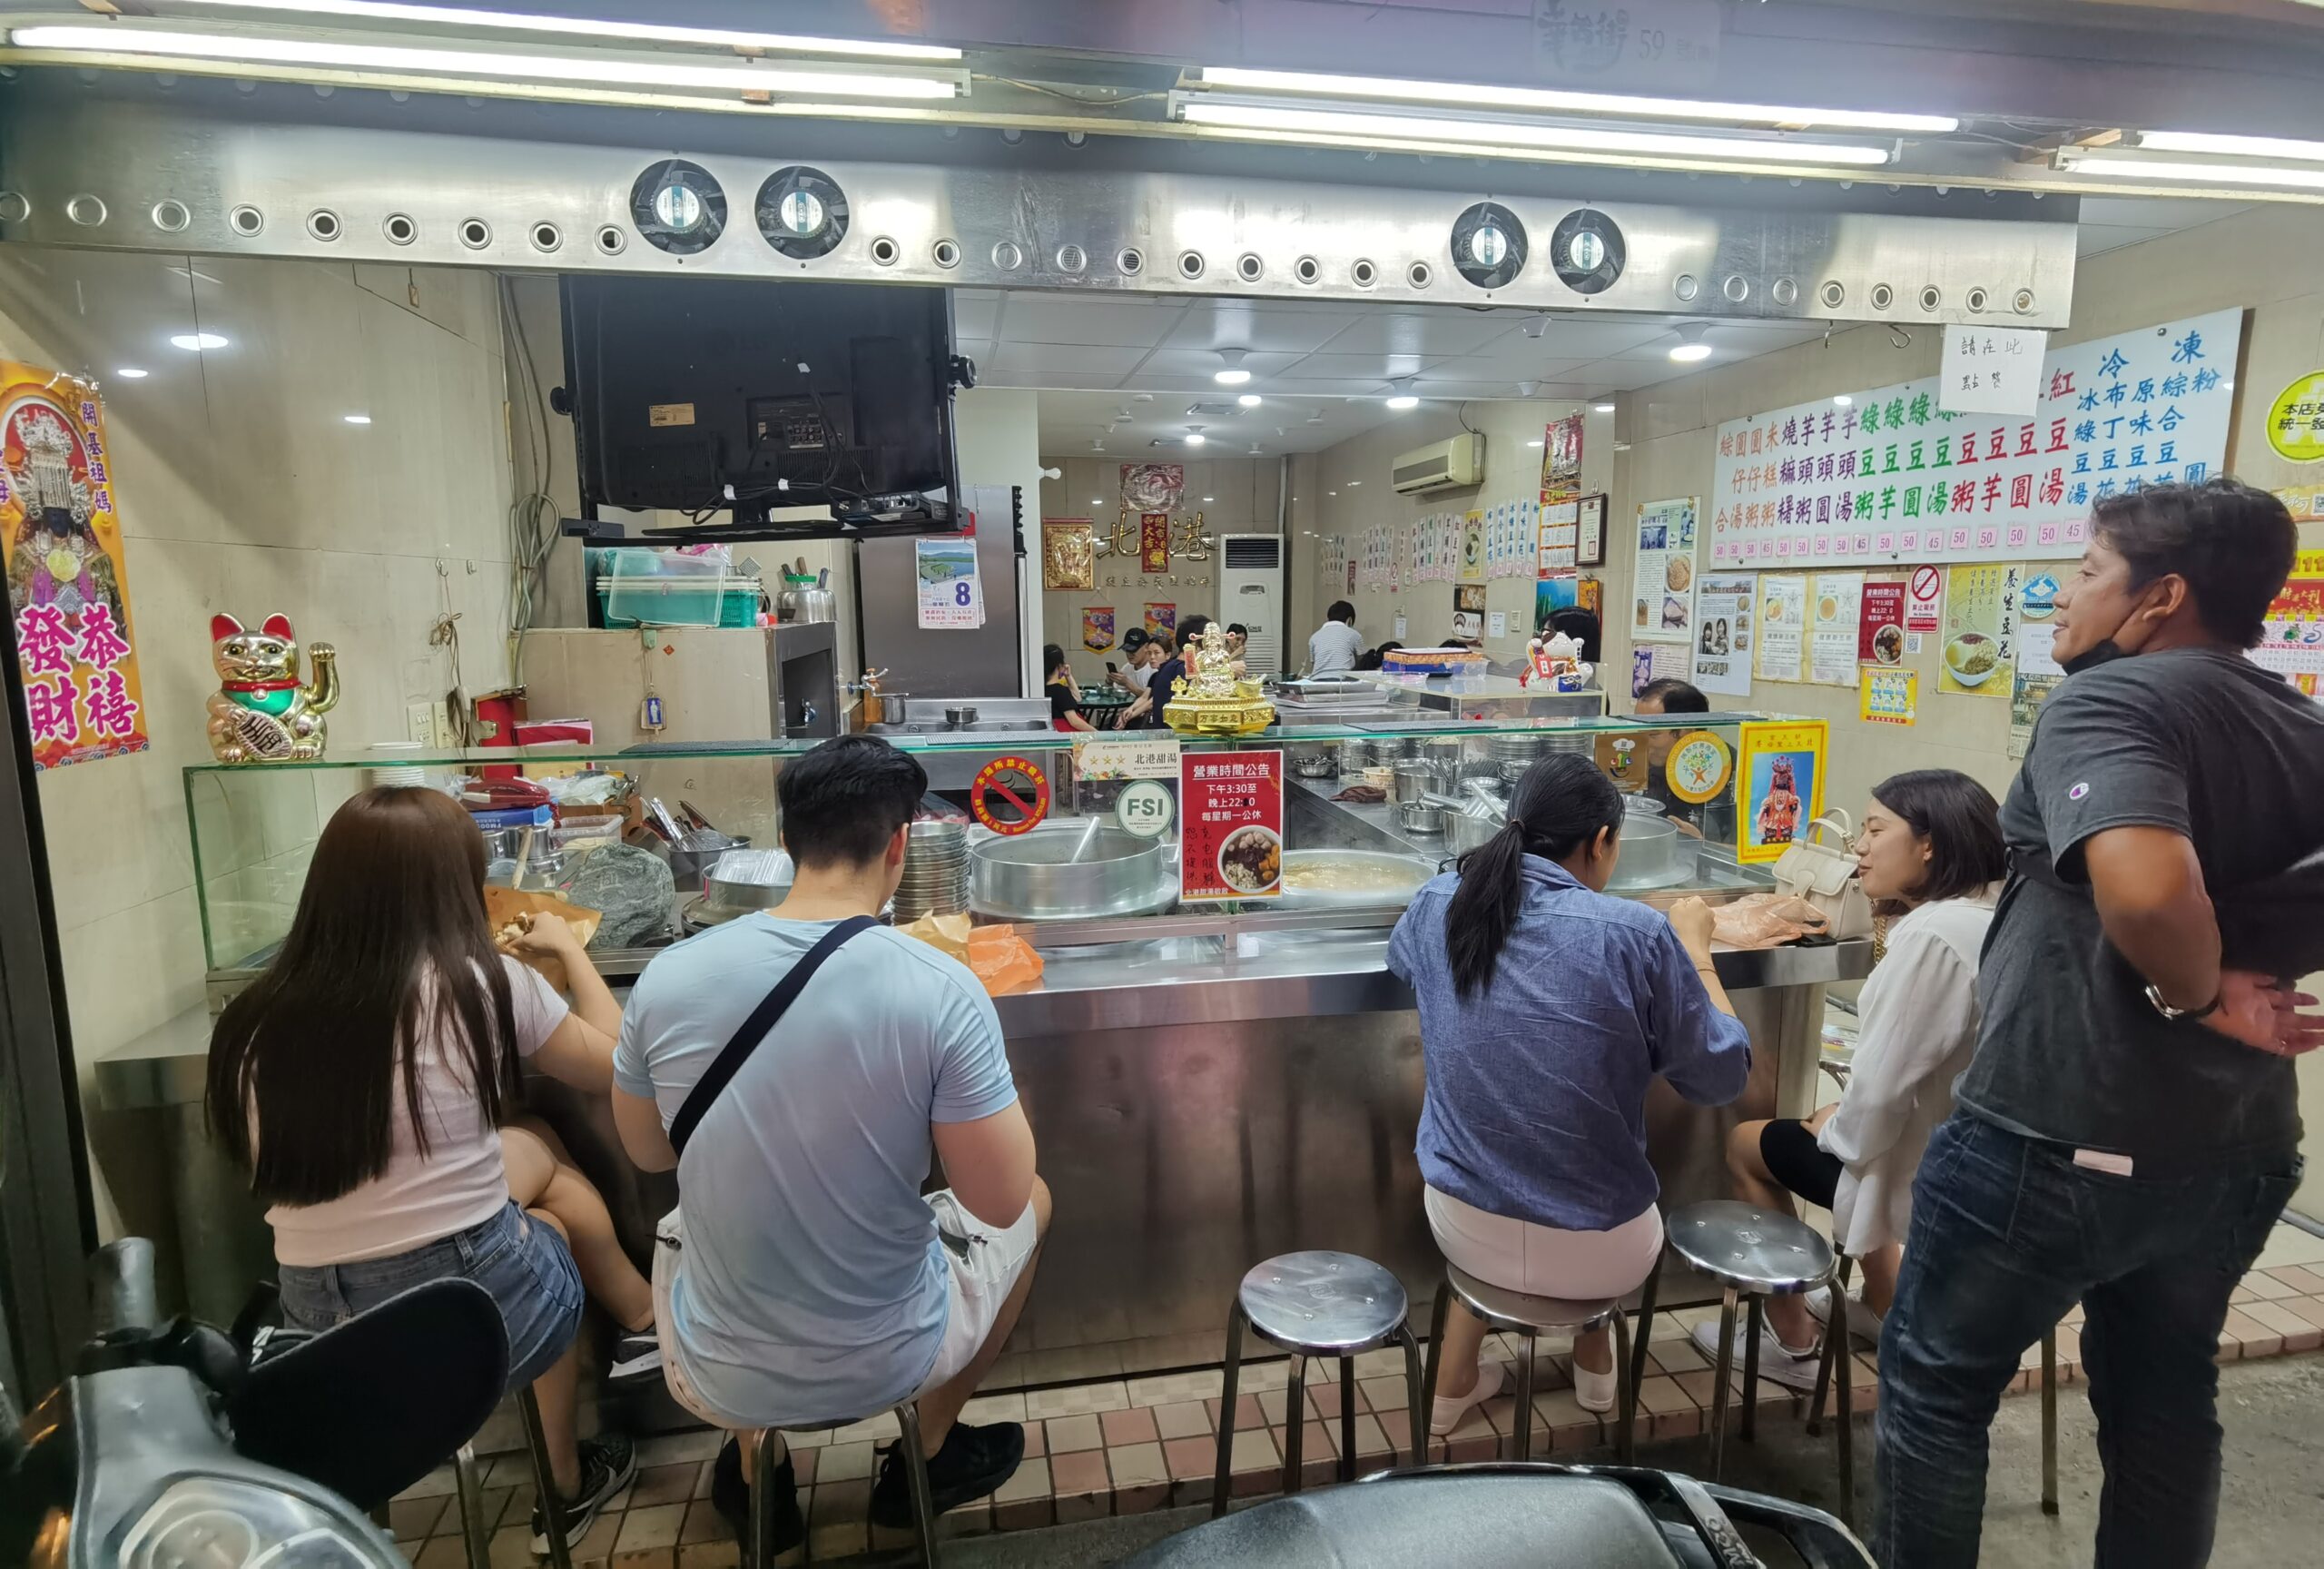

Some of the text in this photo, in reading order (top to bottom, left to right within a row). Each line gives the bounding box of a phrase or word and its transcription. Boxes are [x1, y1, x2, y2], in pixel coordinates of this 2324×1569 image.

[1961, 334, 2024, 356] 請在此
[81, 401, 111, 513] 開基祖媽
[1729, 430, 1748, 530] 圓仔湯
[1745, 427, 1762, 529] 圓仔粥
[1795, 412, 1815, 526] 芋頭粥
[1816, 408, 1836, 525] 芋頭圓
[1835, 405, 1857, 523] 芋頭湯
[1854, 401, 1880, 521] 綠豆粥
[1877, 396, 1905, 520] 綠豆芋
[1903, 391, 1931, 518] 綠豆圓
[1950, 431, 1979, 514] 豆粥
[1981, 427, 2008, 513] 豆芋
[2010, 422, 2038, 509] 豆圓
[2039, 368, 2076, 507] 紅豆湯
[2067, 388, 2101, 507] 冰綠豆湯
[1779, 542, 1787, 552] 50
[1797, 541, 1806, 551] 50
[1817, 540, 1826, 550] 50
[1837, 540, 1846, 550] 50
[1856, 538, 1866, 549] 45
[1880, 538, 1890, 548] 50
[1904, 536, 1914, 547] 50
[1928, 538, 1939, 548] 45
[1954, 532, 1965, 544] 50
[1980, 531, 1993, 544] 50
[2011, 529, 2023, 542] 50
[2042, 528, 2055, 540] 50
[2066, 524, 2080, 537] 45
[955, 582, 971, 607] 8
[1997, 567, 2018, 659] 養生豆花
[18, 604, 77, 744] 發財
[79, 603, 136, 735] 恭禧
[1128, 798, 1164, 816] FSI
[1135, 753, 1177, 765] 北港甜湯
[1193, 763, 1271, 778] 營業時間公告
[1206, 783, 1257, 795] 下午3:30至
[1208, 797, 1256, 808] 晚上22:0
[1201, 810, 1262, 822] 每星期一公休
